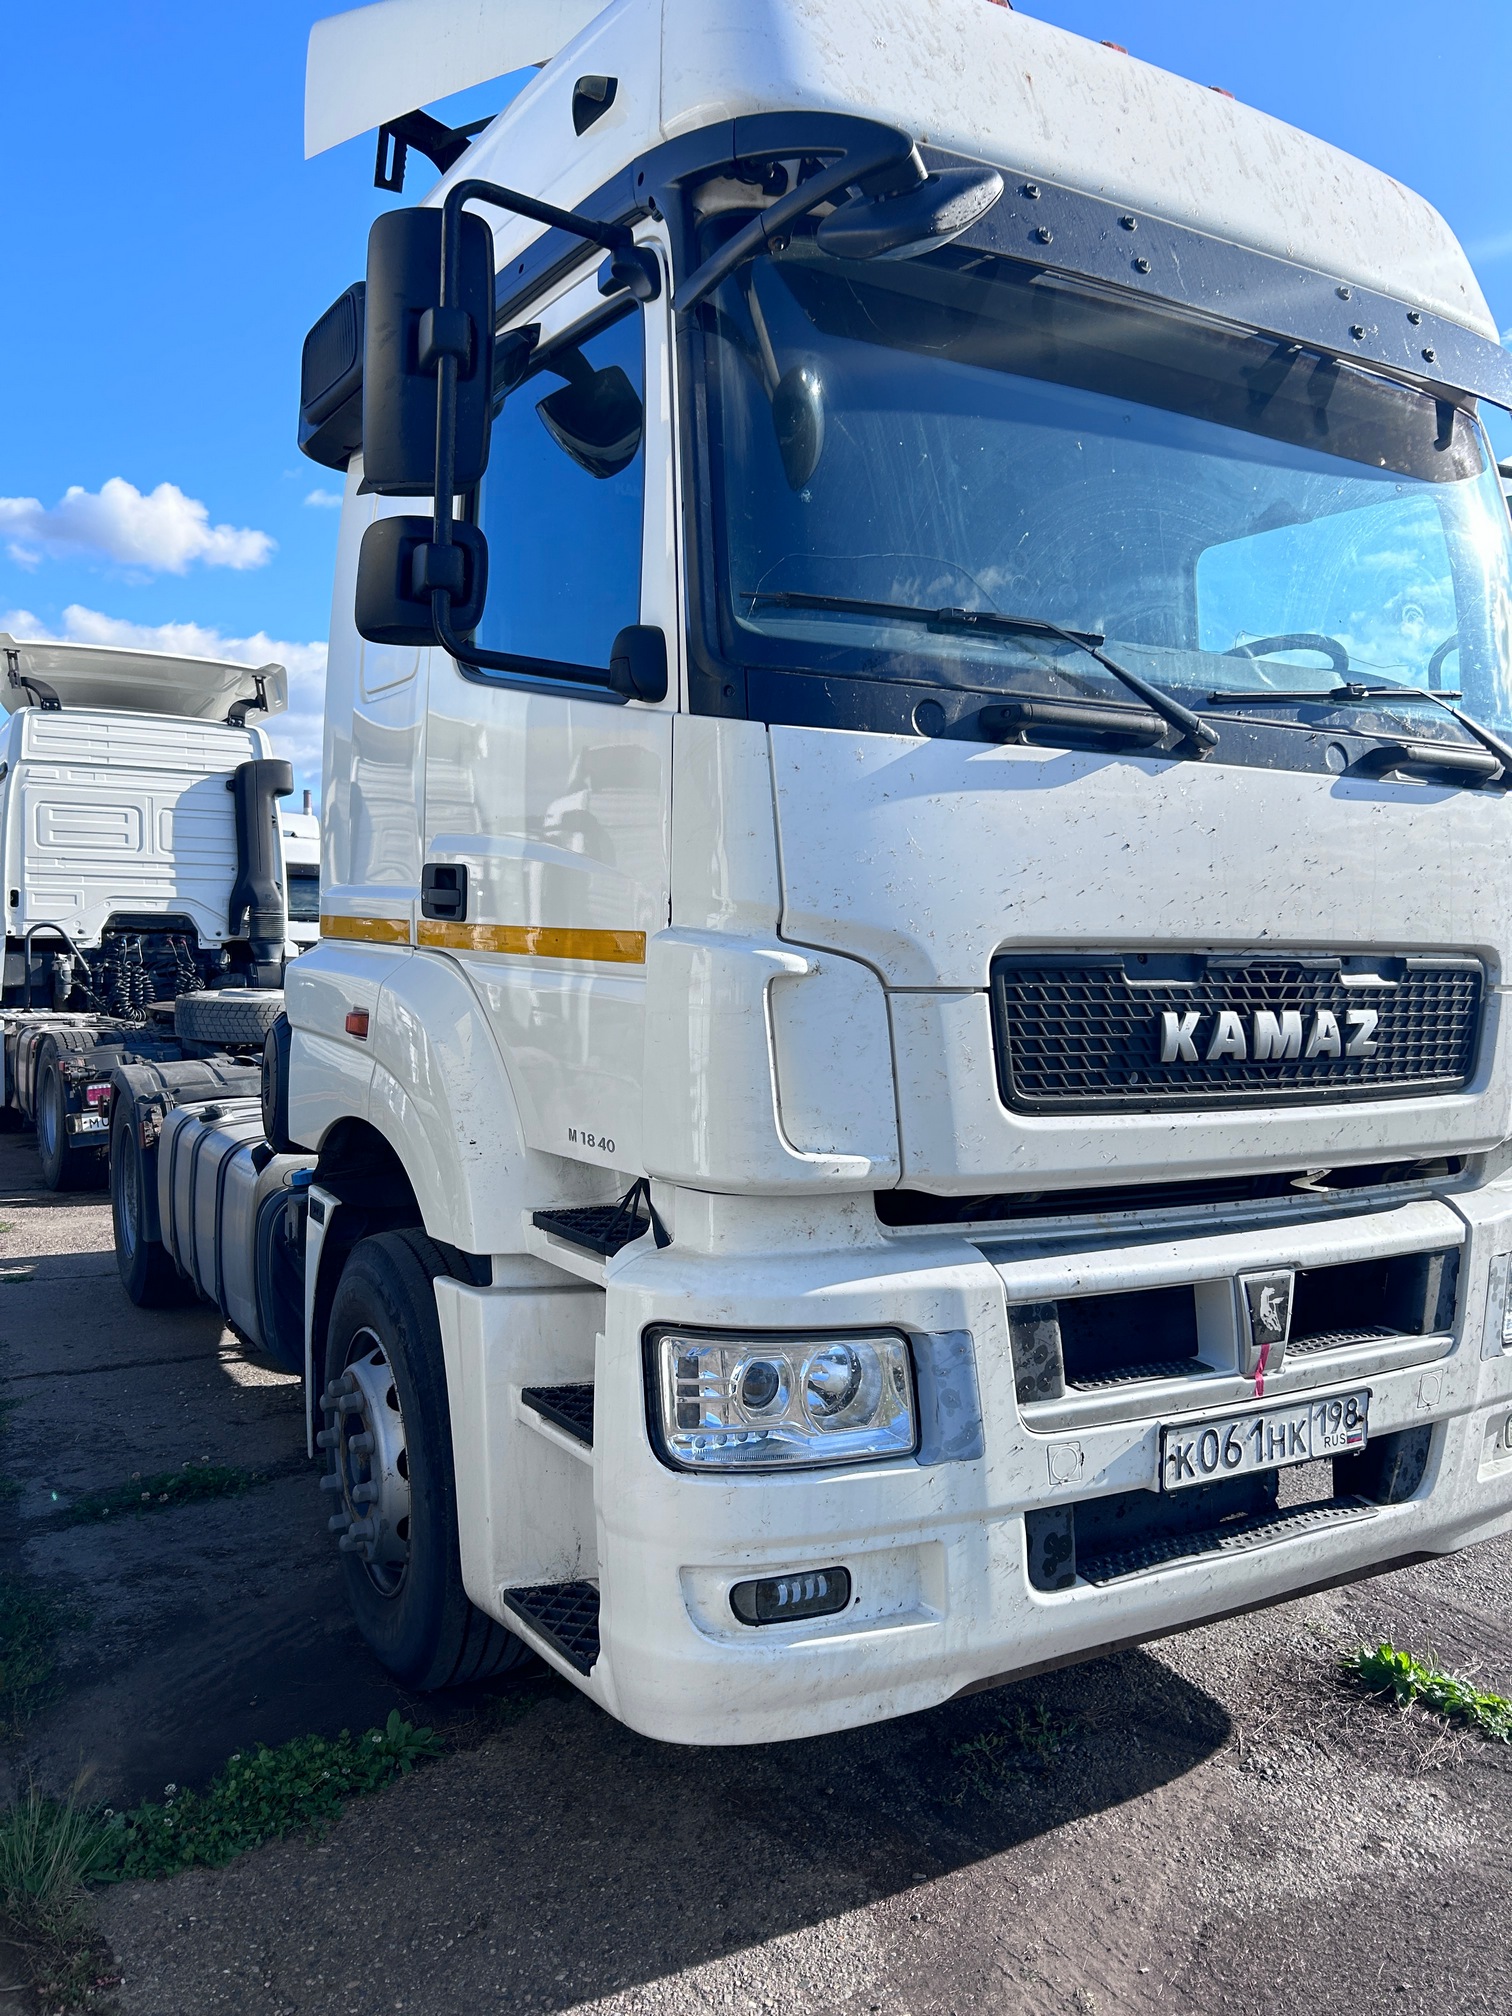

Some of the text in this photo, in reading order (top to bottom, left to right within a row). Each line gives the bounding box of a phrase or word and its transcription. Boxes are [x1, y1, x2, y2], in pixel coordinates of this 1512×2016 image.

[1161, 1009, 1378, 1062] KAMAZ
[1313, 1398, 1358, 1436] 198
[1324, 1433, 1346, 1448] RUS
